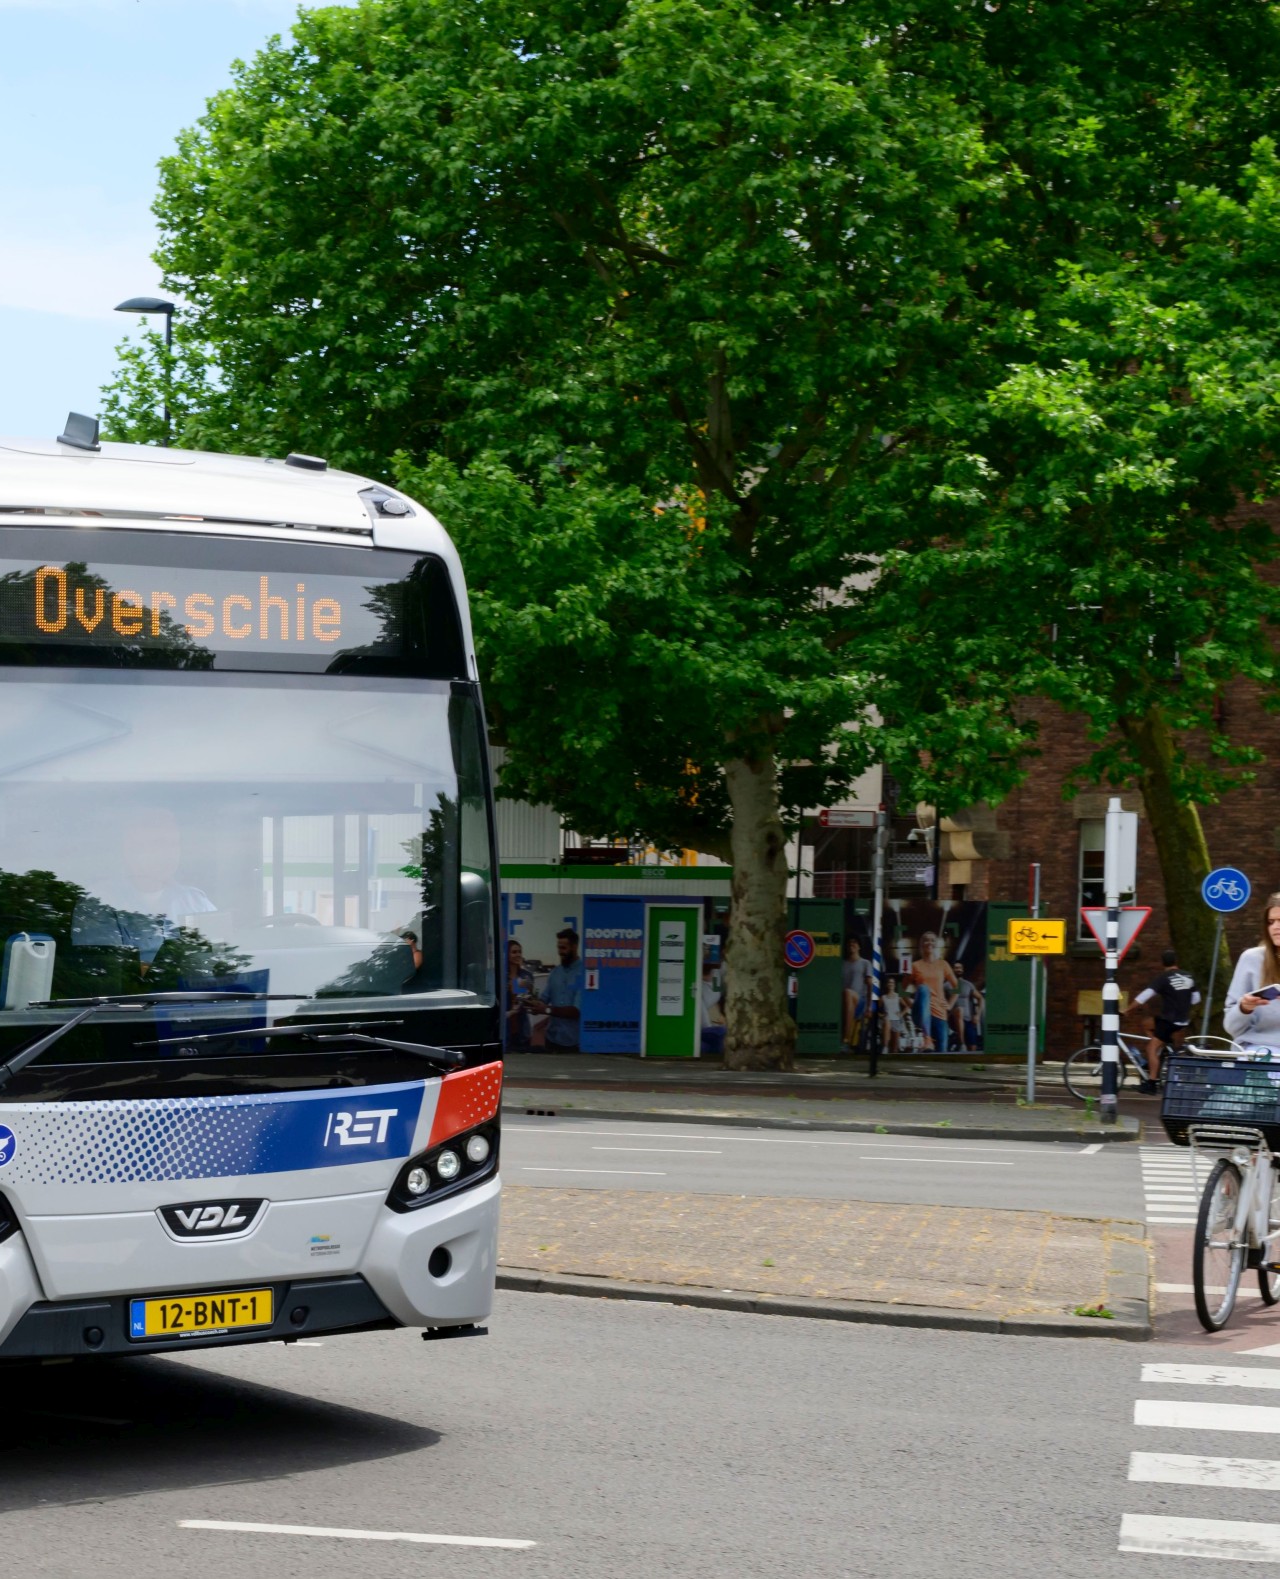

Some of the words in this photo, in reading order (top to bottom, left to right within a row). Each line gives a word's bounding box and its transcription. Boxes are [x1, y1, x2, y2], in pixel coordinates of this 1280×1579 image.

[35, 565, 342, 643] Overschie
[585, 928, 642, 939] ROOFTOP
[585, 949, 613, 958] BEST
[614, 949, 641, 958] VIEW
[323, 1108, 399, 1147] RET
[174, 1205, 247, 1230] VDL
[160, 1296, 257, 1329] 12-BNT-1
[133, 1322, 144, 1331] NL
